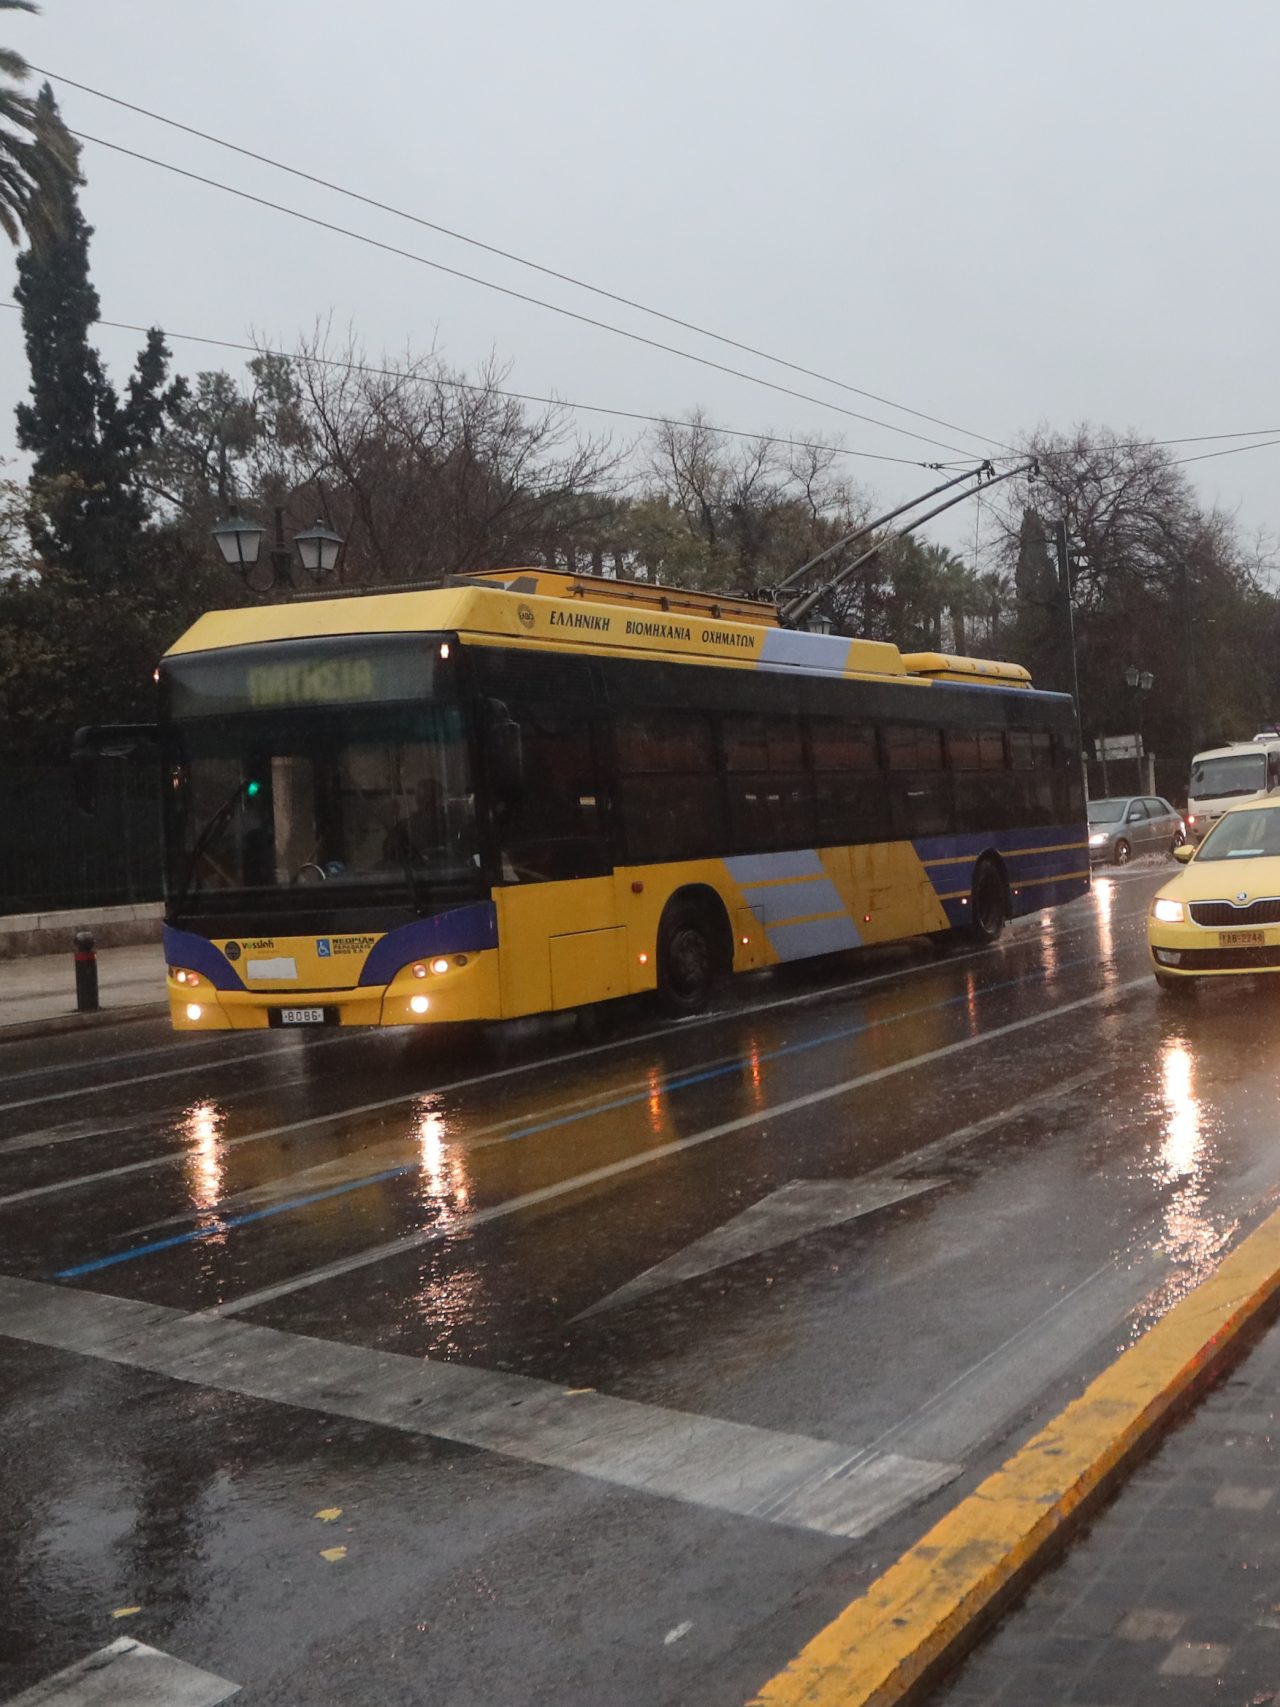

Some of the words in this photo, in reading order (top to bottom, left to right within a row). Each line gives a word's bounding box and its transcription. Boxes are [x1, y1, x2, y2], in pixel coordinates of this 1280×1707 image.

[549, 610, 611, 632] ΕΛΛΗΝΙΚΗ
[625, 620, 692, 642] ΒΙΟΜΗΧΑΝΙΑ
[701, 629, 756, 649] ΟΧΗΜΑΤΩΝ
[287, 1010, 318, 1022] 8086
